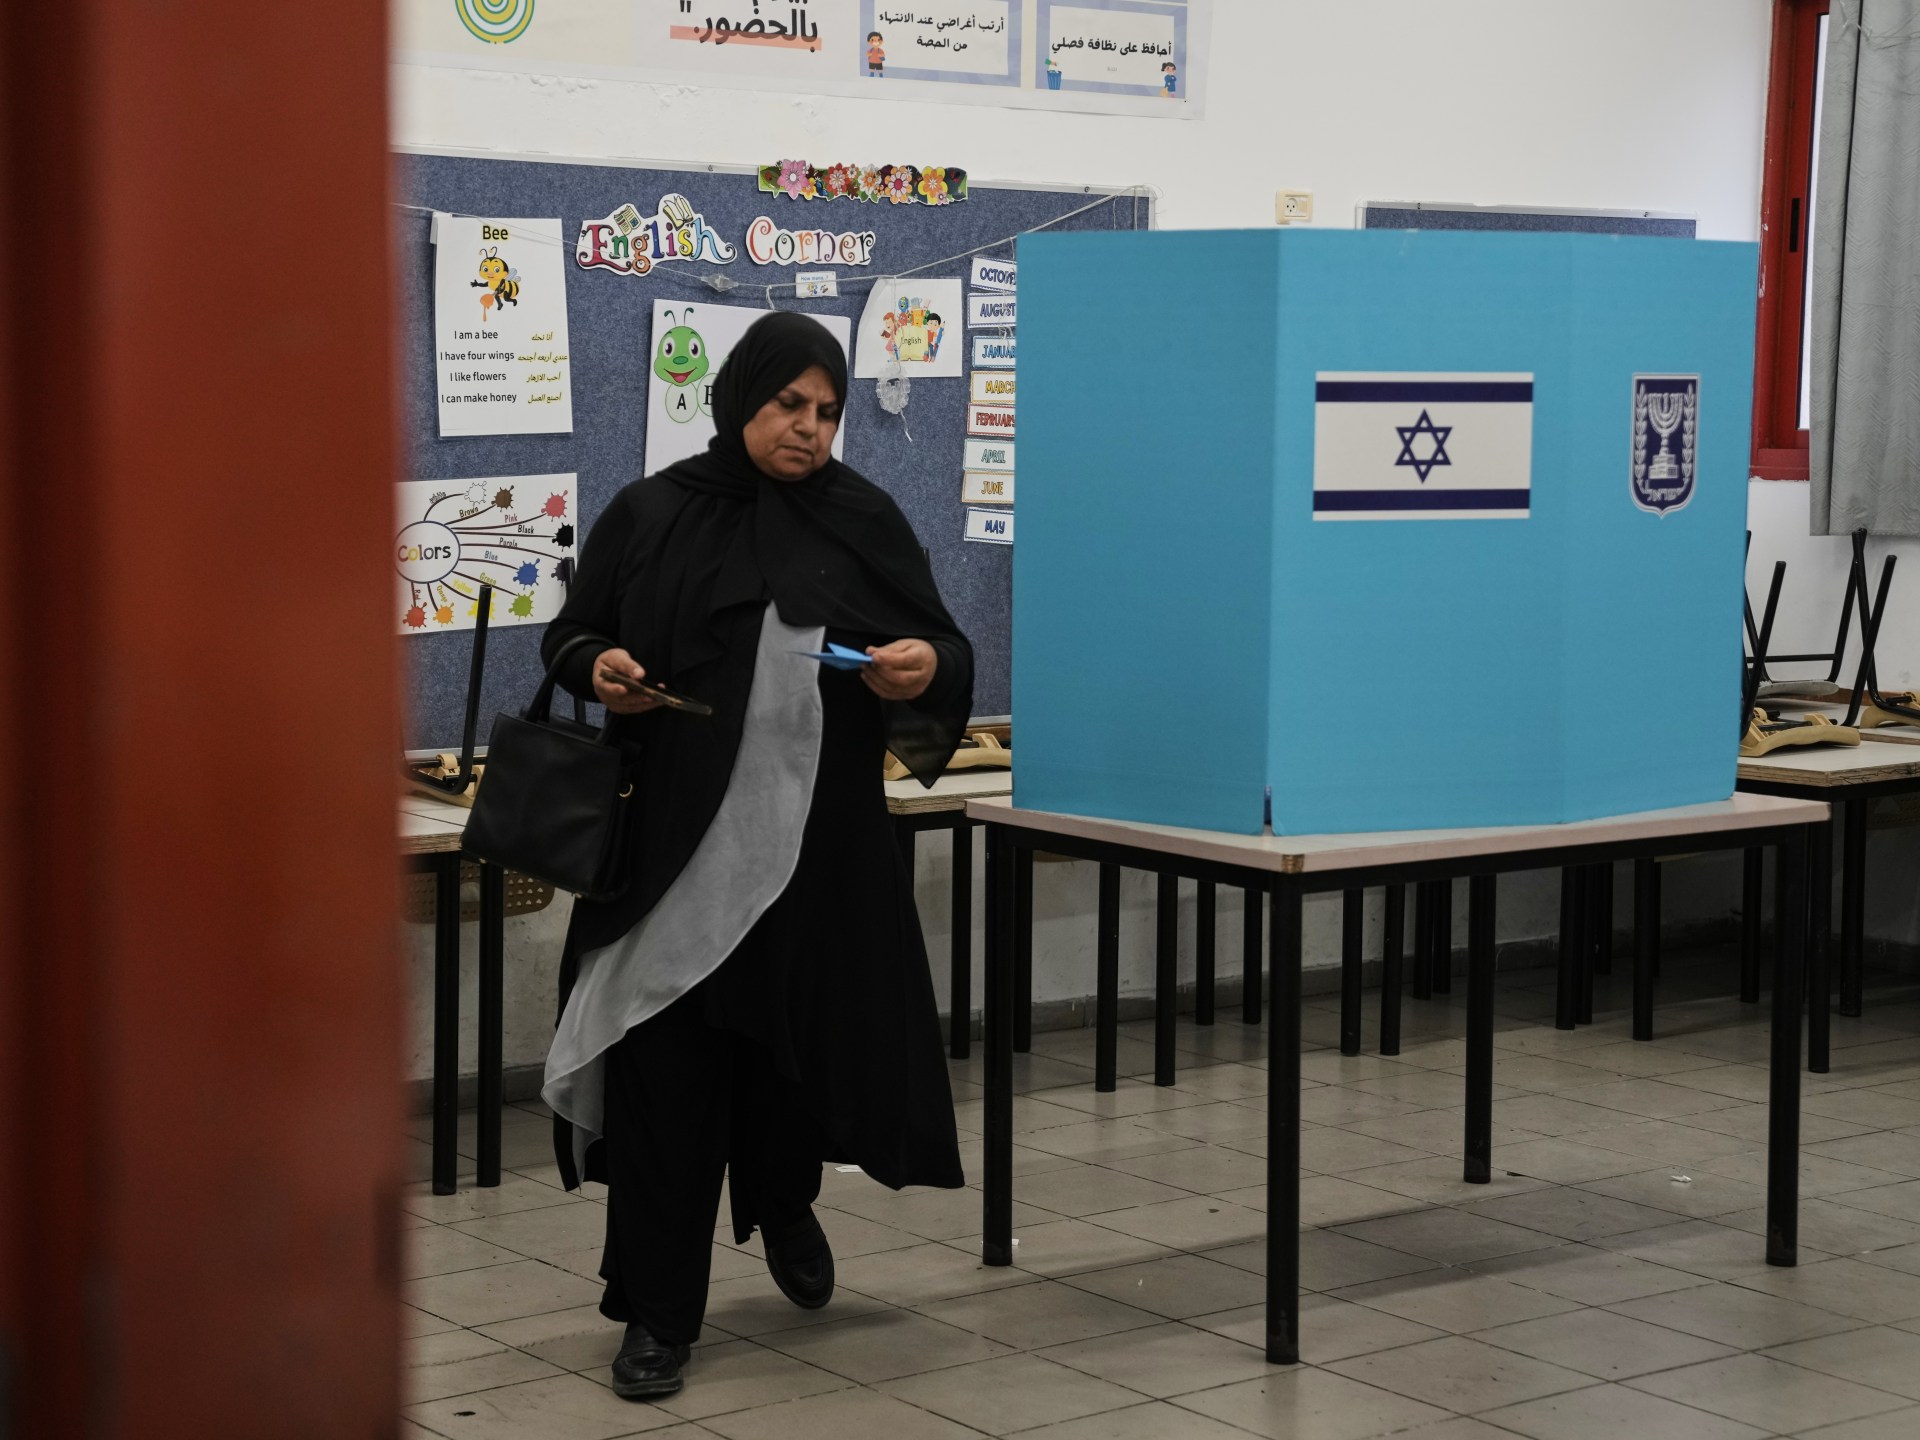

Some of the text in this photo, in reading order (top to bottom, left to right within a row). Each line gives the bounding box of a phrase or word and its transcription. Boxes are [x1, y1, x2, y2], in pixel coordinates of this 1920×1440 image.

[879, 11, 1004, 33] أرتب أغراضي عند الانتهاء
[694, 9, 818, 52] بالحضور.
[953, 42, 968, 51] من
[1051, 36, 1084, 53] فصلي
[1087, 38, 1117, 51] نظافة
[1119, 42, 1138, 55] على
[482, 225, 509, 240] Bee
[579, 216, 875, 274] English Corner
[482, 330, 499, 339] bee
[901, 337, 922, 345] English
[445, 351, 466, 361] have
[467, 351, 487, 361] four
[488, 351, 515, 363] wings
[455, 372, 471, 381] like
[472, 372, 507, 381] flowers
[446, 395, 462, 403] can
[464, 393, 488, 403] make
[489, 393, 517, 405] honey
[676, 393, 687, 410] A
[981, 449, 1006, 463] APRIL
[981, 481, 1004, 495] JUNE
[459, 506, 479, 518] Brown
[504, 513, 518, 523] Pink
[517, 524, 534, 534] Black
[985, 520, 1005, 534] MAY
[397, 544, 452, 562] Colors
[484, 550, 498, 561] Blue
